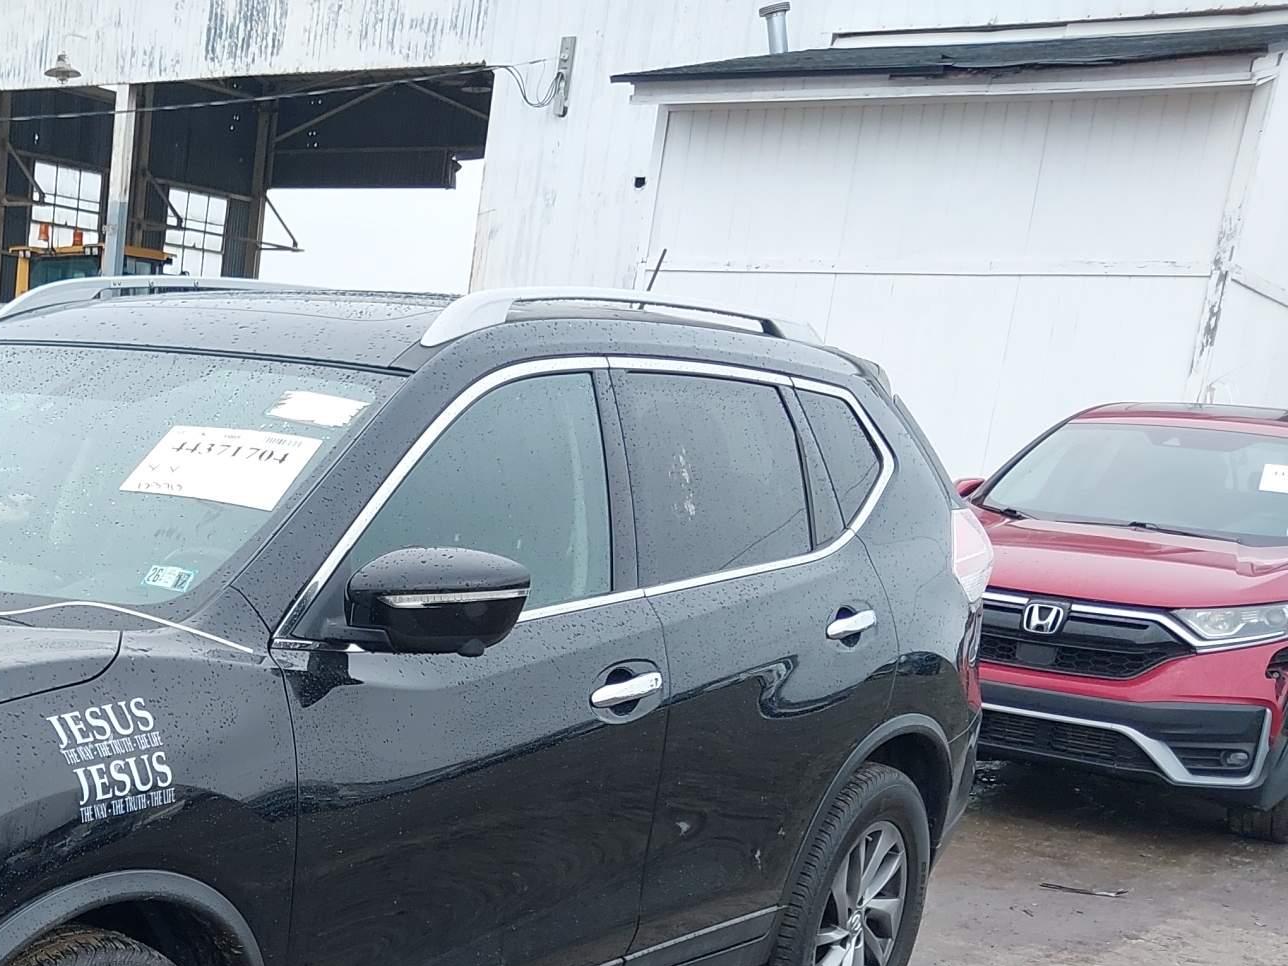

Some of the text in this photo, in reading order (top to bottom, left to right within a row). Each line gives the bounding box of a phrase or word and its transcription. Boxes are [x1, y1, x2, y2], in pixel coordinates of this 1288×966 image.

[172, 441, 290, 465] 44371704
[46, 697, 154, 749] JESUS
[61, 748, 81, 765] THE
[73, 751, 172, 806] JESUS
[80, 787, 176, 824] THE WAY THE TRUTH THE LIFE
